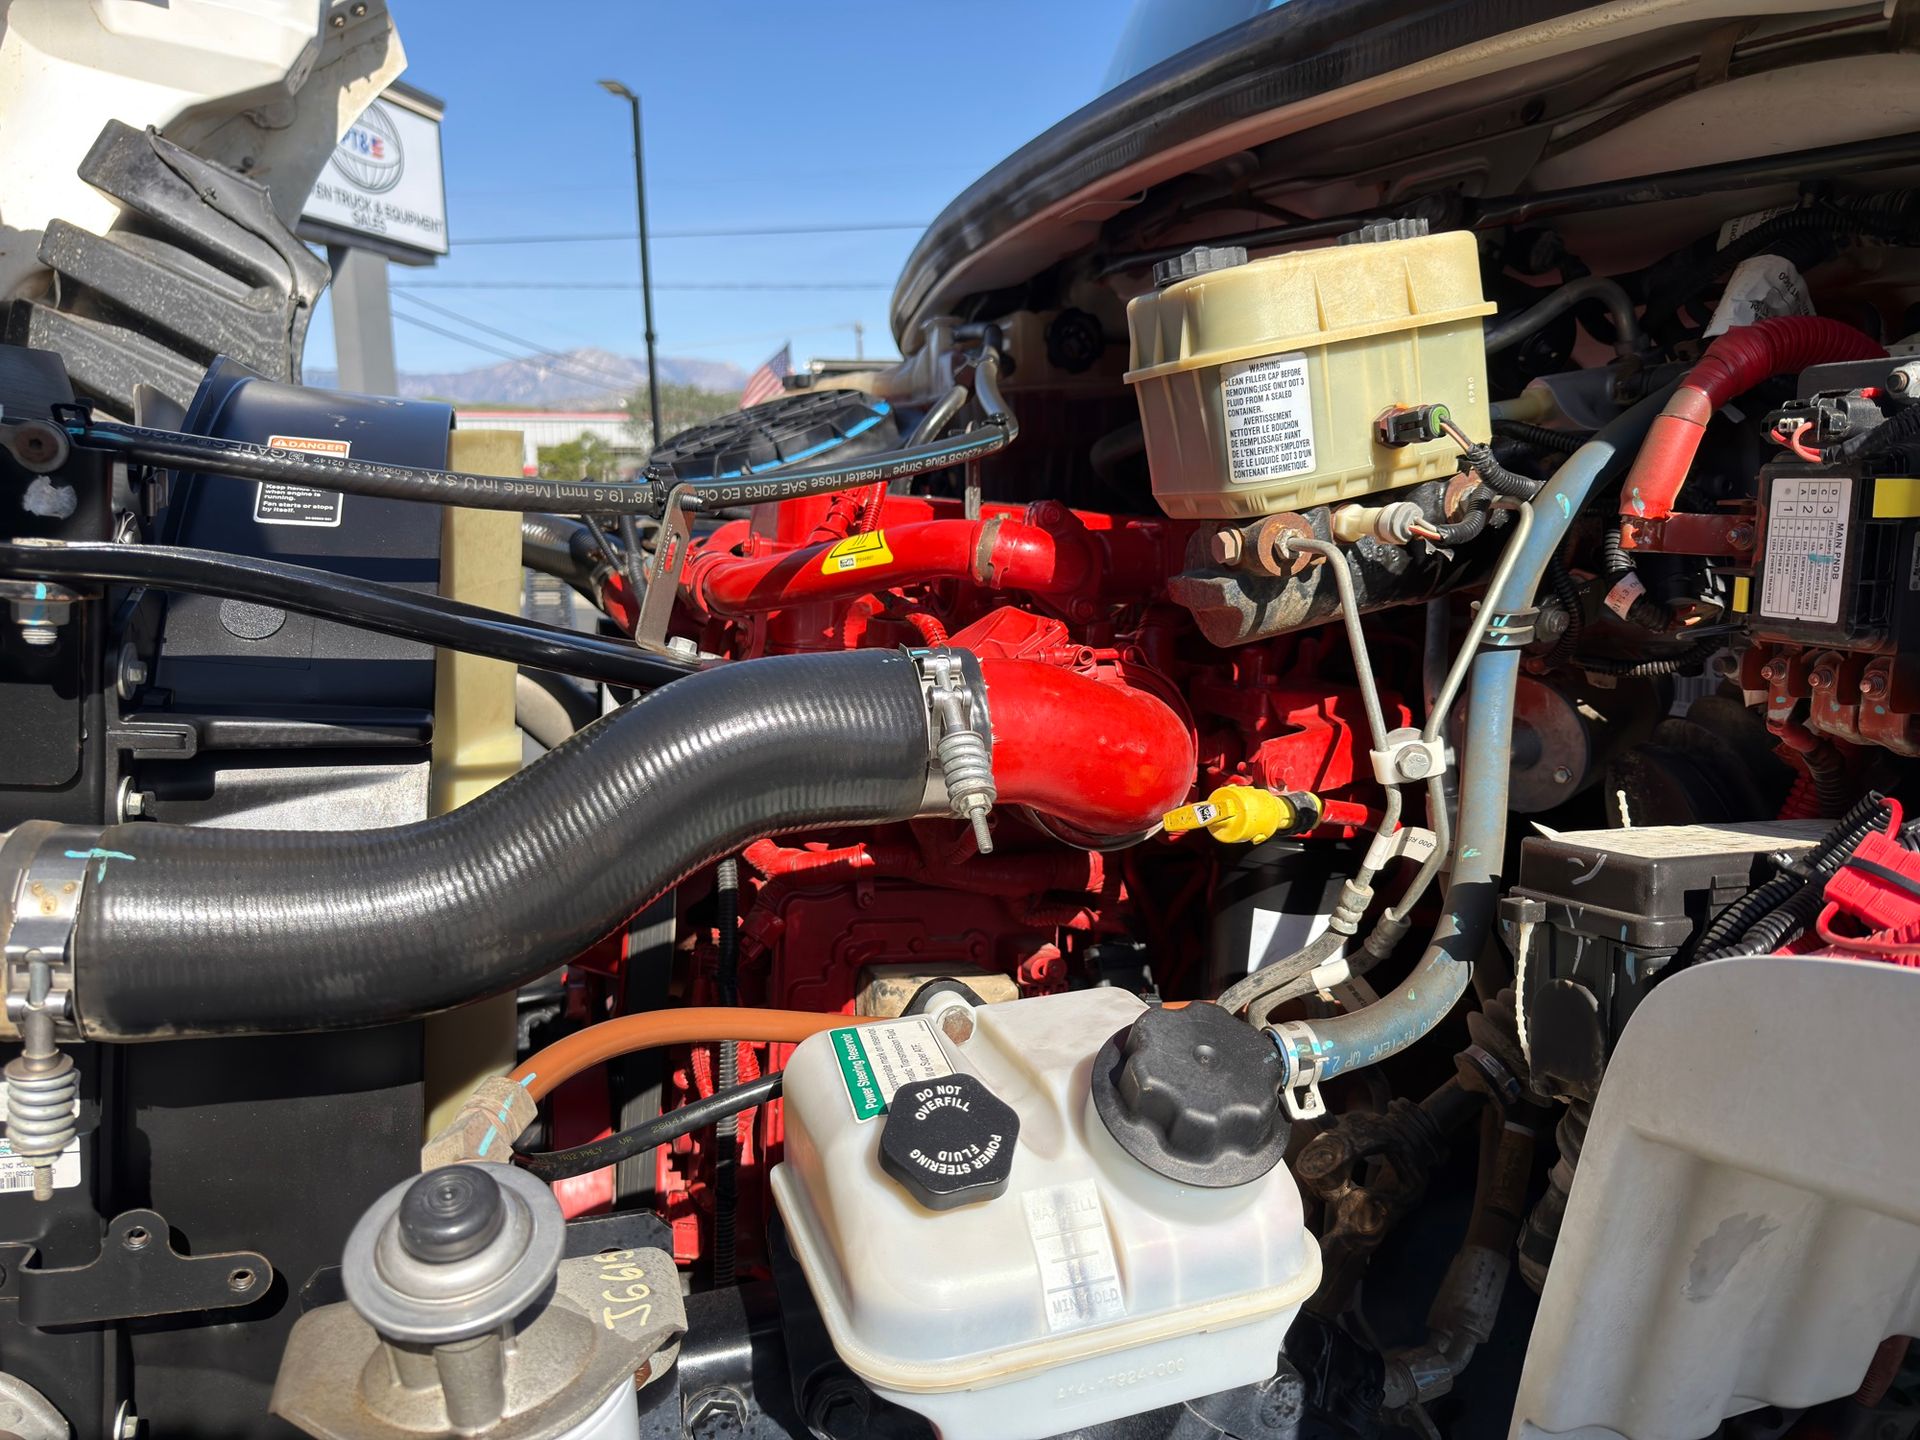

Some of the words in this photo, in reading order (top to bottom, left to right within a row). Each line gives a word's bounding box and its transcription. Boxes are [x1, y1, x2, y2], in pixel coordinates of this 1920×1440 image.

[333, 187, 373, 213] TRUCK
[374, 201, 384, 216] &
[385, 202, 444, 233] EQUIPMENT
[352, 211, 387, 232] SALES
[1249, 360, 1281, 373] WARNING
[1225, 377, 1244, 388] CLEAN
[1245, 374, 1267, 385] FILLER
[1268, 371, 1279, 381] CAP
[1281, 368, 1301, 379] BEFORE
[1273, 381, 1287, 390] ONLY
[1288, 379, 1299, 388] DOT
[1301, 378, 1305, 386] 3
[1227, 397, 1244, 407] FLUID
[1245, 396, 1264, 406] FROM
[1265, 394, 1270, 402] A
[1271, 390, 1292, 401] SEALED
[1227, 405, 1264, 418] CONTAINER.
[1243, 410, 1292, 426] AVERTISSEMENT
[1230, 426, 1260, 438] NETTOYER
[1262, 425, 1269, 433] LE
[1271, 420, 1299, 432] BOUCHON
[288, 441, 345, 452] DANGER
[1231, 439, 1239, 448] DE
[1240, 433, 1283, 447] REMPLISSAGE
[1284, 429, 1301, 440] AVANT
[1232, 449, 1239, 458] DE
[1233, 459, 1244, 469] QUE
[1246, 458, 1253, 467] LE
[1254, 455, 1279, 466] LIQUIDE
[1281, 453, 1292, 462] DOT
[1293, 451, 1298, 460] 3
[1299, 448, 1312, 459] D'UN
[924, 454, 948, 471] Blue
[1233, 467, 1269, 479] CONTENANT
[1270, 459, 1309, 474] HERMETIQUE.
[810, 475, 840, 489] Hose
[842, 468, 883, 485] Heater
[265, 483, 286, 491] Keep
[482, 479, 499, 493] in
[503, 480, 552, 497] Made
[555, 483, 590, 499] mm]
[723, 486, 741, 500] EC
[745, 484, 779, 498] 20R3
[781, 480, 808, 497] SAE
[264, 494, 296, 502] running.
[593, 488, 625, 503] [9.5
[1802, 505, 1814, 514] 2
[1822, 506, 1834, 515] 3
[1834, 523, 1844, 550] MAIN
[1832, 552, 1841, 581] PNDB
[885, 1028, 896, 1041] Fluid
[840, 1033, 860, 1061] Reservoir
[892, 1039, 911, 1068] Transmission
[879, 1054, 889, 1065] mark
[916, 1053, 930, 1067] Super
[1344, 1050, 1361, 1068] WP
[852, 1059, 871, 1088] Steering
[862, 1087, 879, 1110] Power
[915, 1087, 934, 1103] DO
[936, 1084, 962, 1096] NOT
[915, 1096, 971, 1121] OVERFILL
[937, 1143, 981, 1162] FLUID
[970, 1133, 1002, 1170] POWER
[909, 1148, 972, 1176] STEERING
[1052, 1295, 1078, 1315] MIN
[1086, 1287, 1120, 1304] COLD
